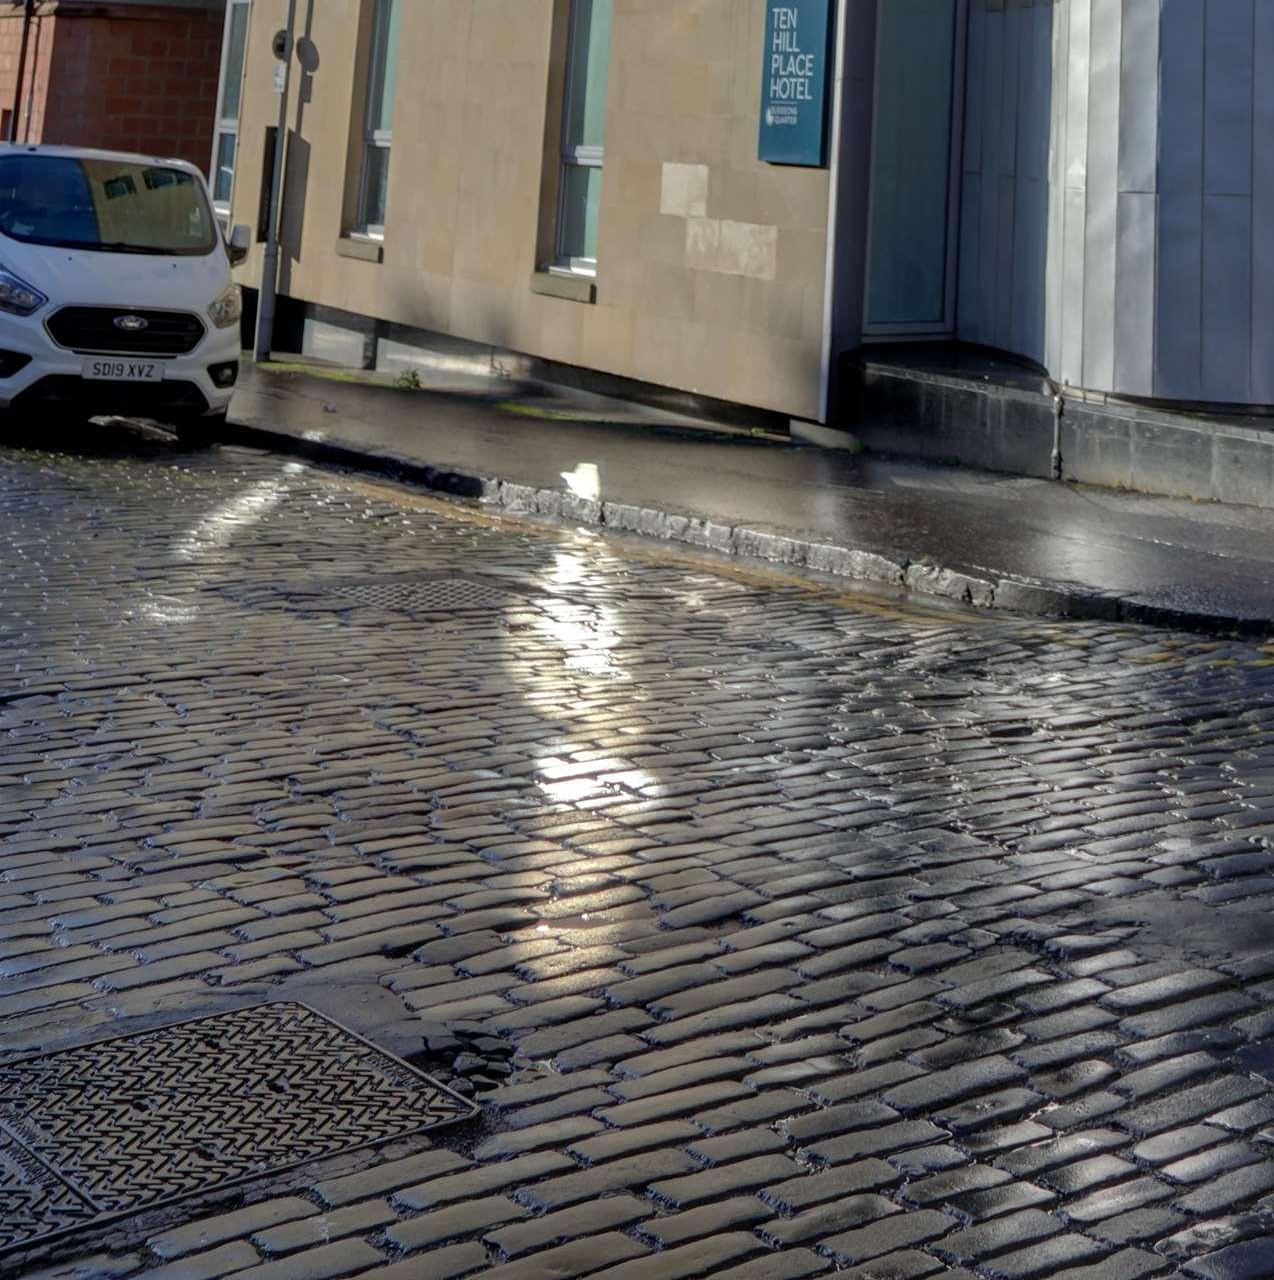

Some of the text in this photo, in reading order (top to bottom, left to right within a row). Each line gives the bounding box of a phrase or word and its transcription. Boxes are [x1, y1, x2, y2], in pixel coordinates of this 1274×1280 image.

[772, 8, 798, 29] TEN
[773, 31, 800, 52] HILL
[771, 54, 814, 77] PLACE
[769, 78, 813, 100] HOTEL
[92, 362, 155, 378] SD19 XVZ
